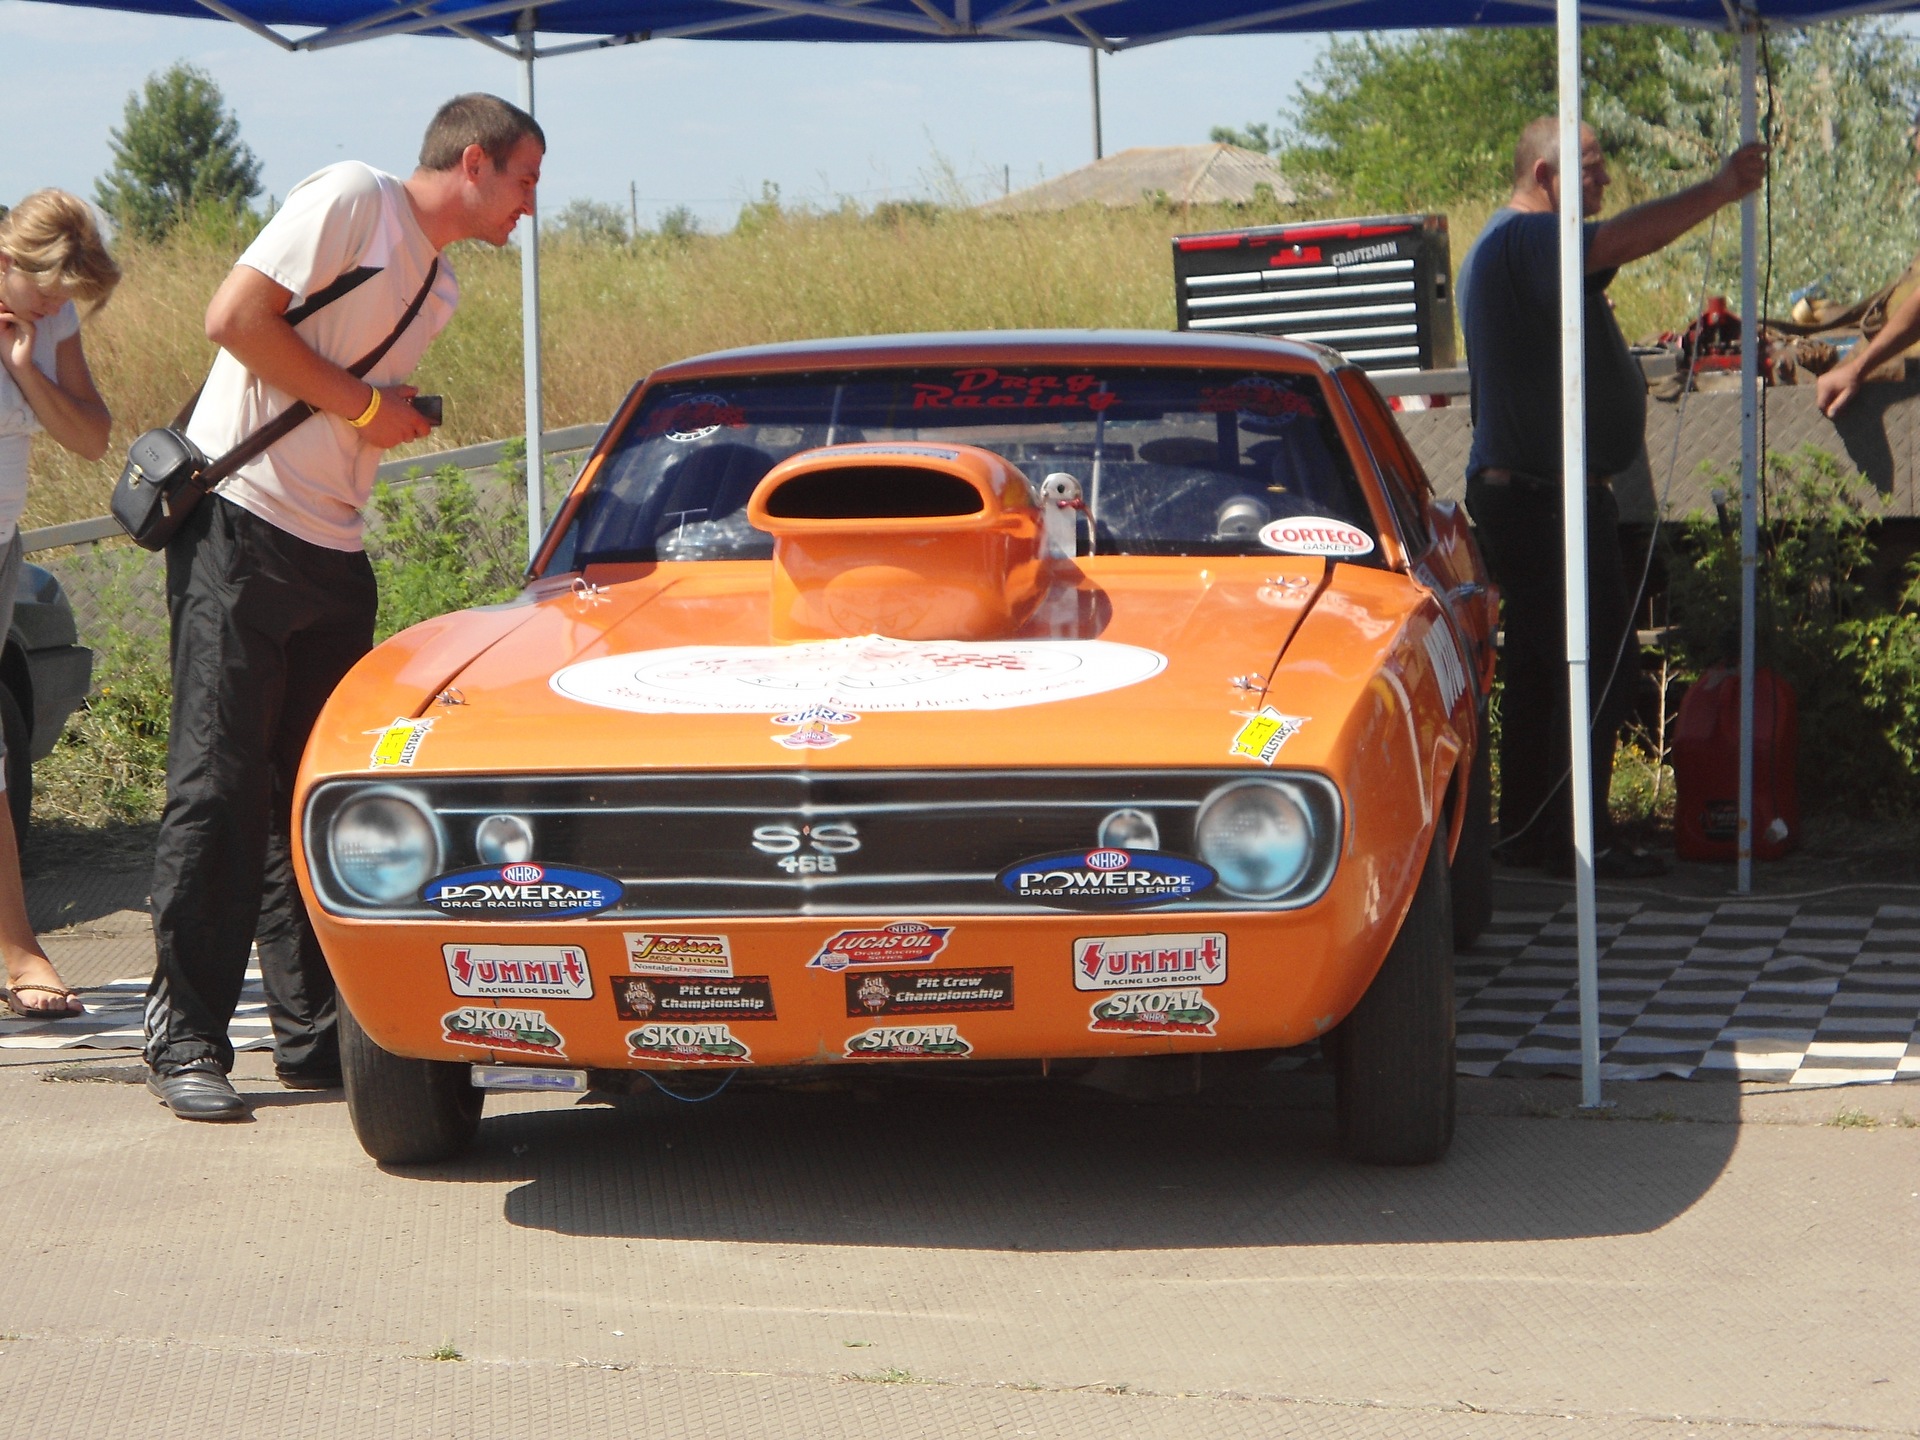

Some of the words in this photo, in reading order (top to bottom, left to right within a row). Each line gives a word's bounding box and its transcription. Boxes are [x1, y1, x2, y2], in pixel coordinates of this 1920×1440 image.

[1332, 241, 1398, 266] CRAFTSMAN
[952, 368, 1100, 392] Drag
[911, 383, 1122, 411] Racing
[1270, 528, 1364, 547] CORTECO
[1303, 543, 1355, 553] GASKETS
[400, 728, 425, 764] ALLSTARS
[1261, 726, 1292, 762] ALLSTARS
[777, 855, 837, 873] 468
[1090, 853, 1125, 868] NHRA
[507, 867, 540, 882] NHRA
[1020, 871, 1192, 888] POWERADE
[441, 885, 603, 900] POWERADE
[1020, 888, 1063, 896] DRAG
[1070, 887, 1129, 895] RACING
[891, 925, 923, 933] NHRA
[633, 934, 723, 958] Jackson
[832, 935, 900, 950] LUCAS
[902, 935, 932, 947] OIL
[1080, 937, 1220, 980] SUMMIT
[451, 948, 585, 988] SUMMIT
[634, 963, 729, 975] NostalgiaDrags.com
[680, 985, 701, 995] Pit
[705, 985, 741, 995] Crew
[916, 978, 939, 988] Pit
[943, 977, 982, 987] Crew
[661, 998, 764, 1010] Championship
[895, 988, 1004, 1002] Championship
[1107, 990, 1202, 1015] SKOAL
[458, 1009, 546, 1032] SKOAL
[642, 1027, 732, 1046] SKOAL
[862, 1027, 958, 1048] SKOAL
